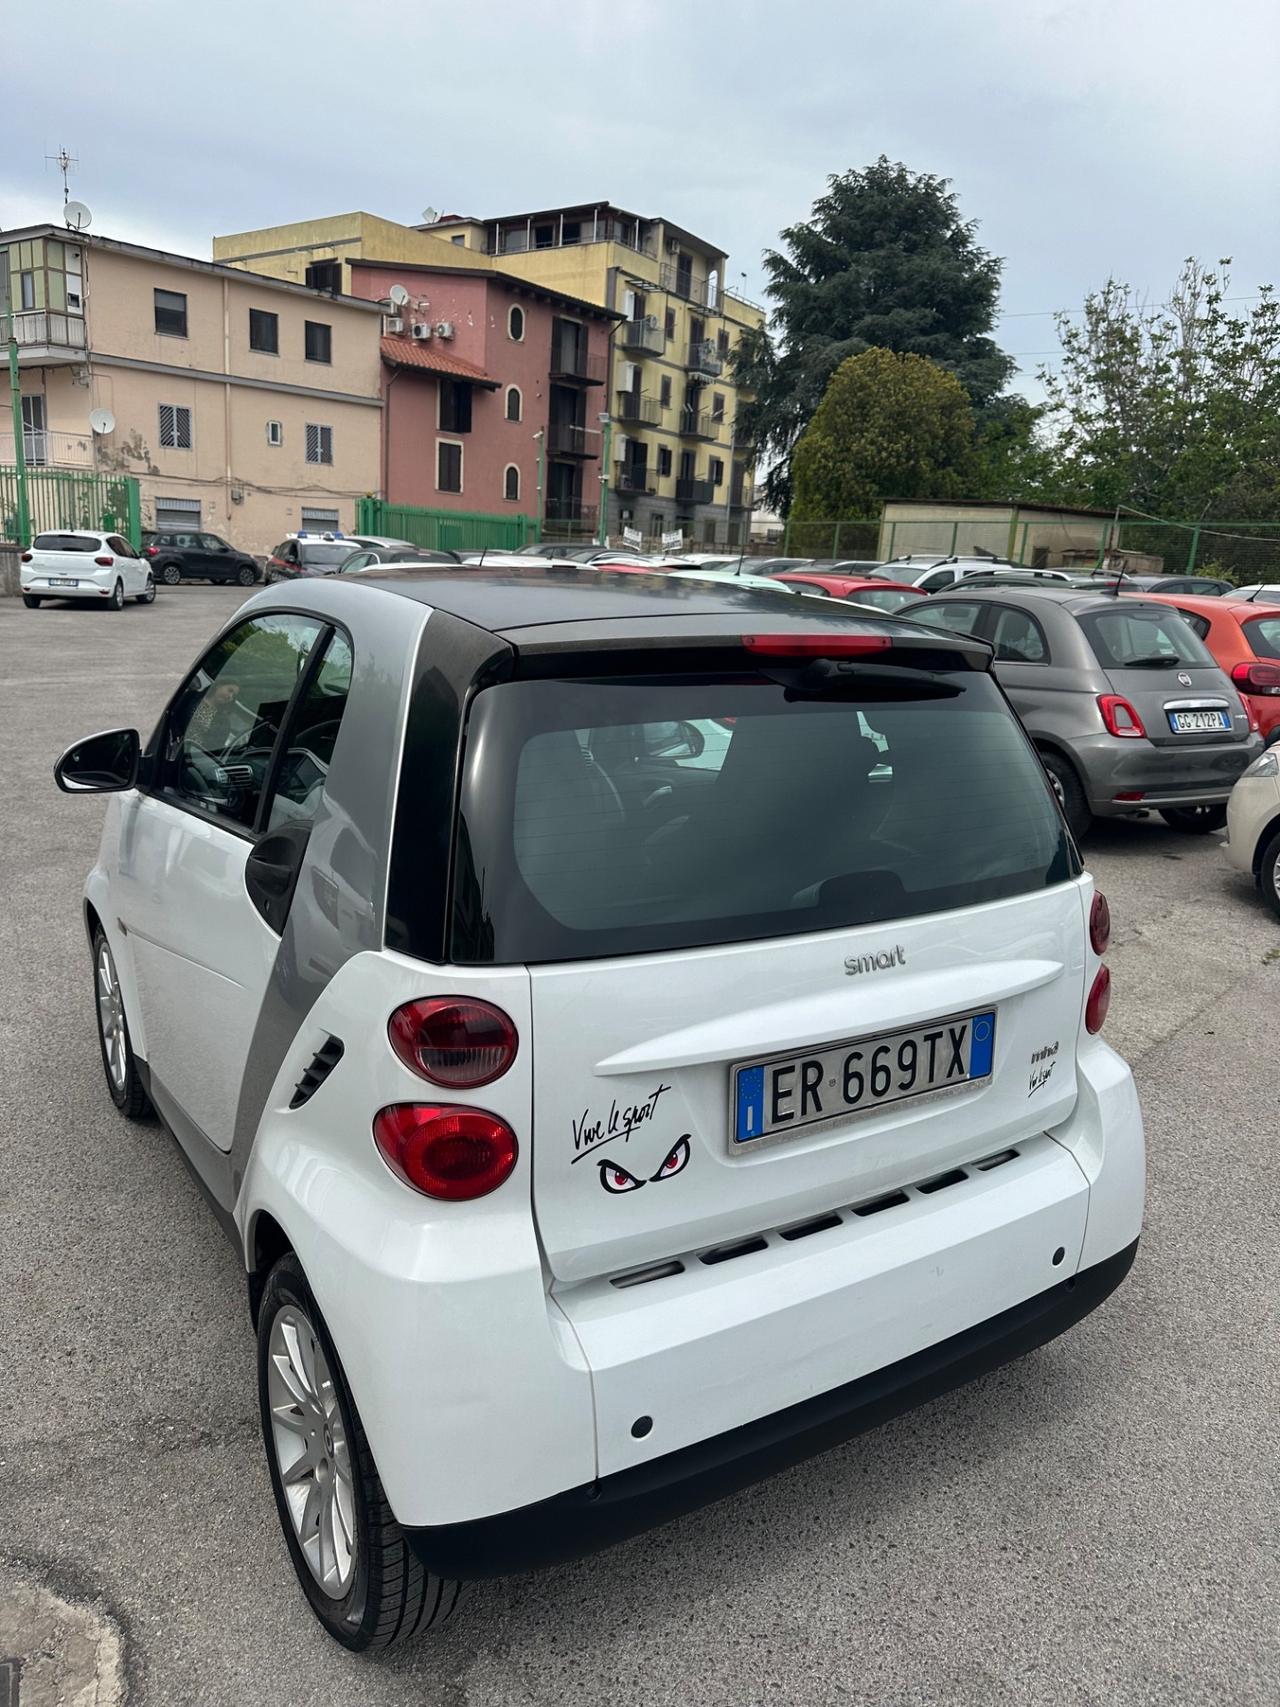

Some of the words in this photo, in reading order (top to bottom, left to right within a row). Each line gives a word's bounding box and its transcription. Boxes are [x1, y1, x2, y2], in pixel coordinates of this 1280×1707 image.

[844, 944, 906, 976] smart
[771, 1060, 824, 1124] ER
[842, 1025, 967, 1105] 669TX
[622, 1084, 671, 1143] sport
